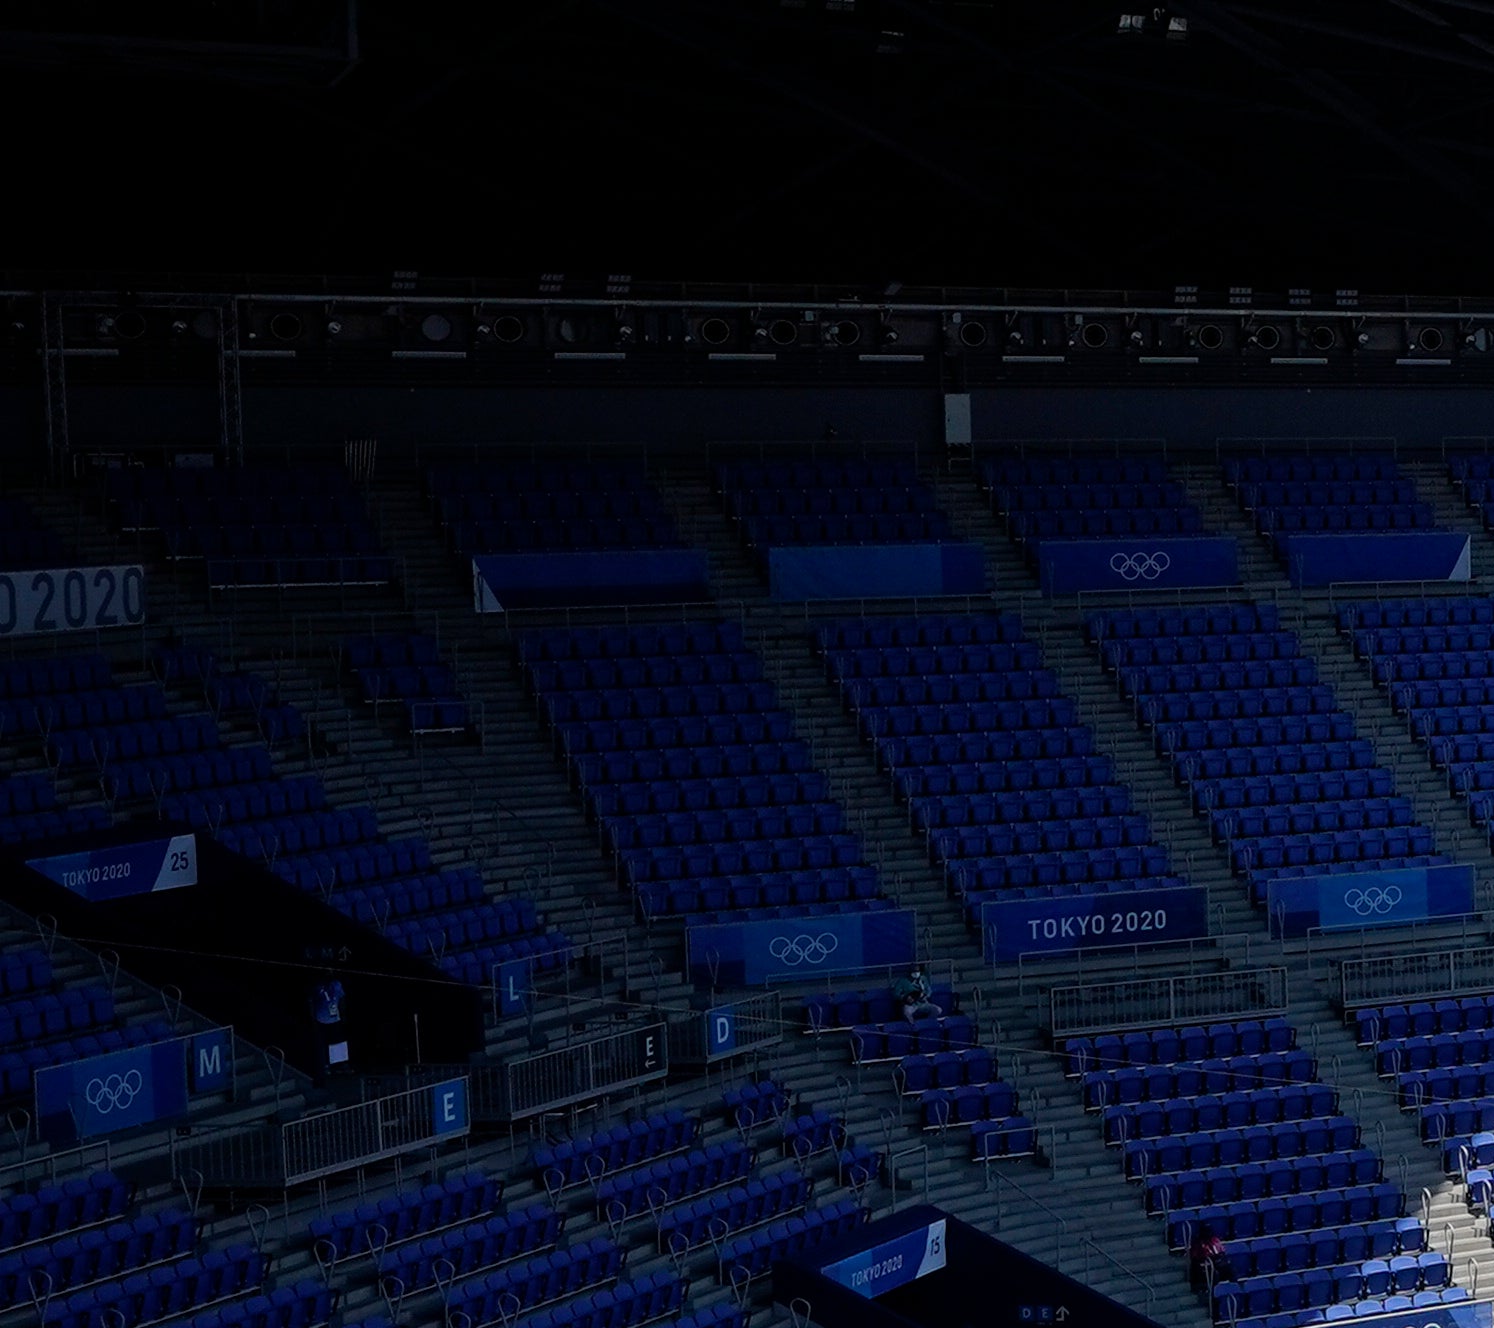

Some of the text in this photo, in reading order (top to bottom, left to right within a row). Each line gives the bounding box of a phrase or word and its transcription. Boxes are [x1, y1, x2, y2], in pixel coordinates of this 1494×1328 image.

[62, 862, 131, 887] TOKYO 2020
[171, 852, 188, 872] 25
[1028, 908, 1168, 942] TOKYO 2020
[510, 976, 519, 1000] L
[717, 1017, 729, 1042] D
[646, 1036, 654, 1056] E
[200, 1046, 221, 1076] M
[444, 1092, 456, 1122] E
[931, 1237, 940, 1255] 15
